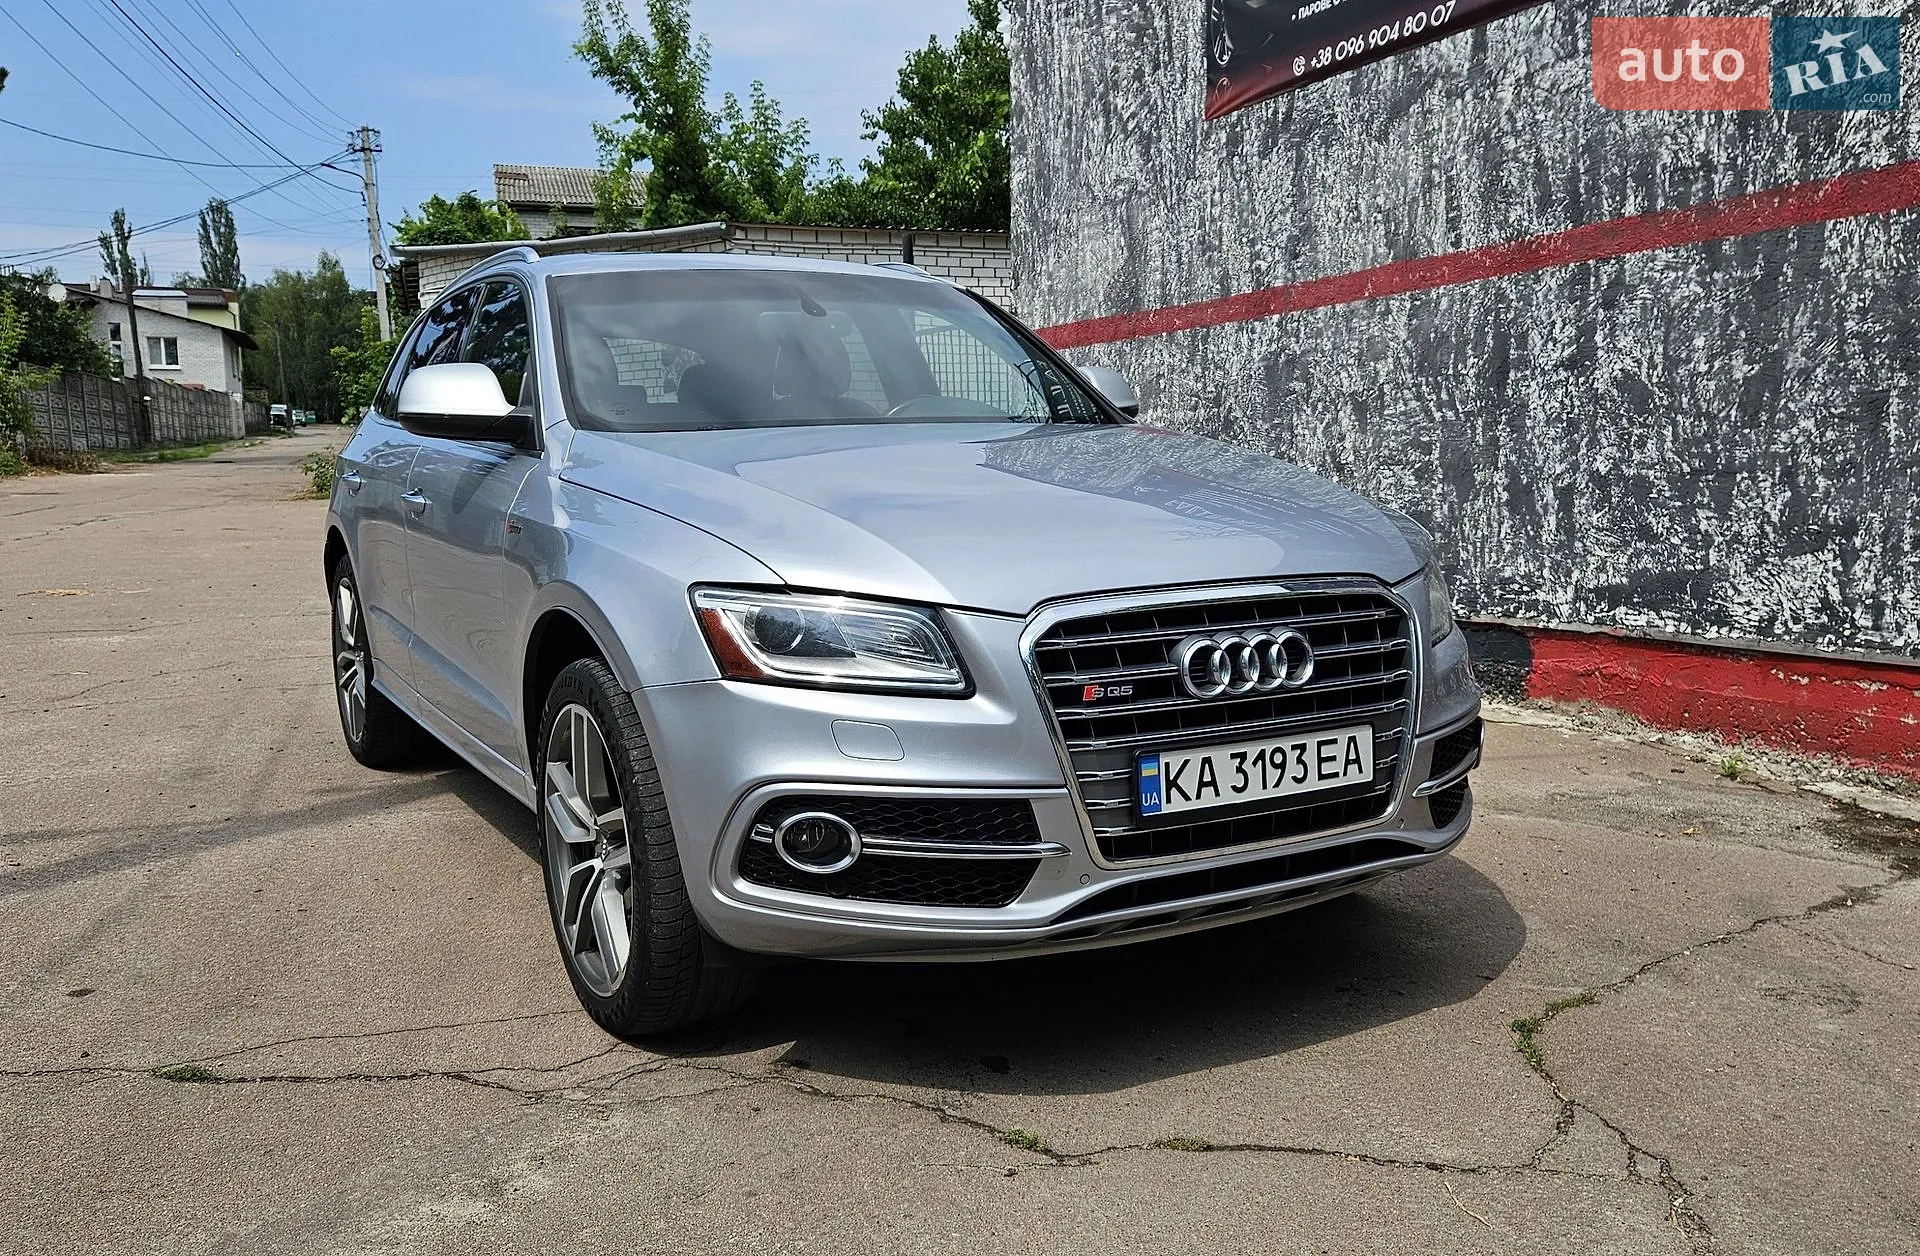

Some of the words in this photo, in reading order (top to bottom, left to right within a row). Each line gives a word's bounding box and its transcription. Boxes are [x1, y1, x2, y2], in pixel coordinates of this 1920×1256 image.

[1310, 46, 1332, 69] +38
[1335, 34, 1365, 61] 096
[1368, 20, 1400, 50] 904
[1403, 11, 1427, 37] 80
[1430, 0, 1456, 27] 07
[1142, 792, 1160, 806] UA
[1163, 756, 1221, 804] KA
[1229, 742, 1308, 794] 3193
[1316, 735, 1363, 781] EA
